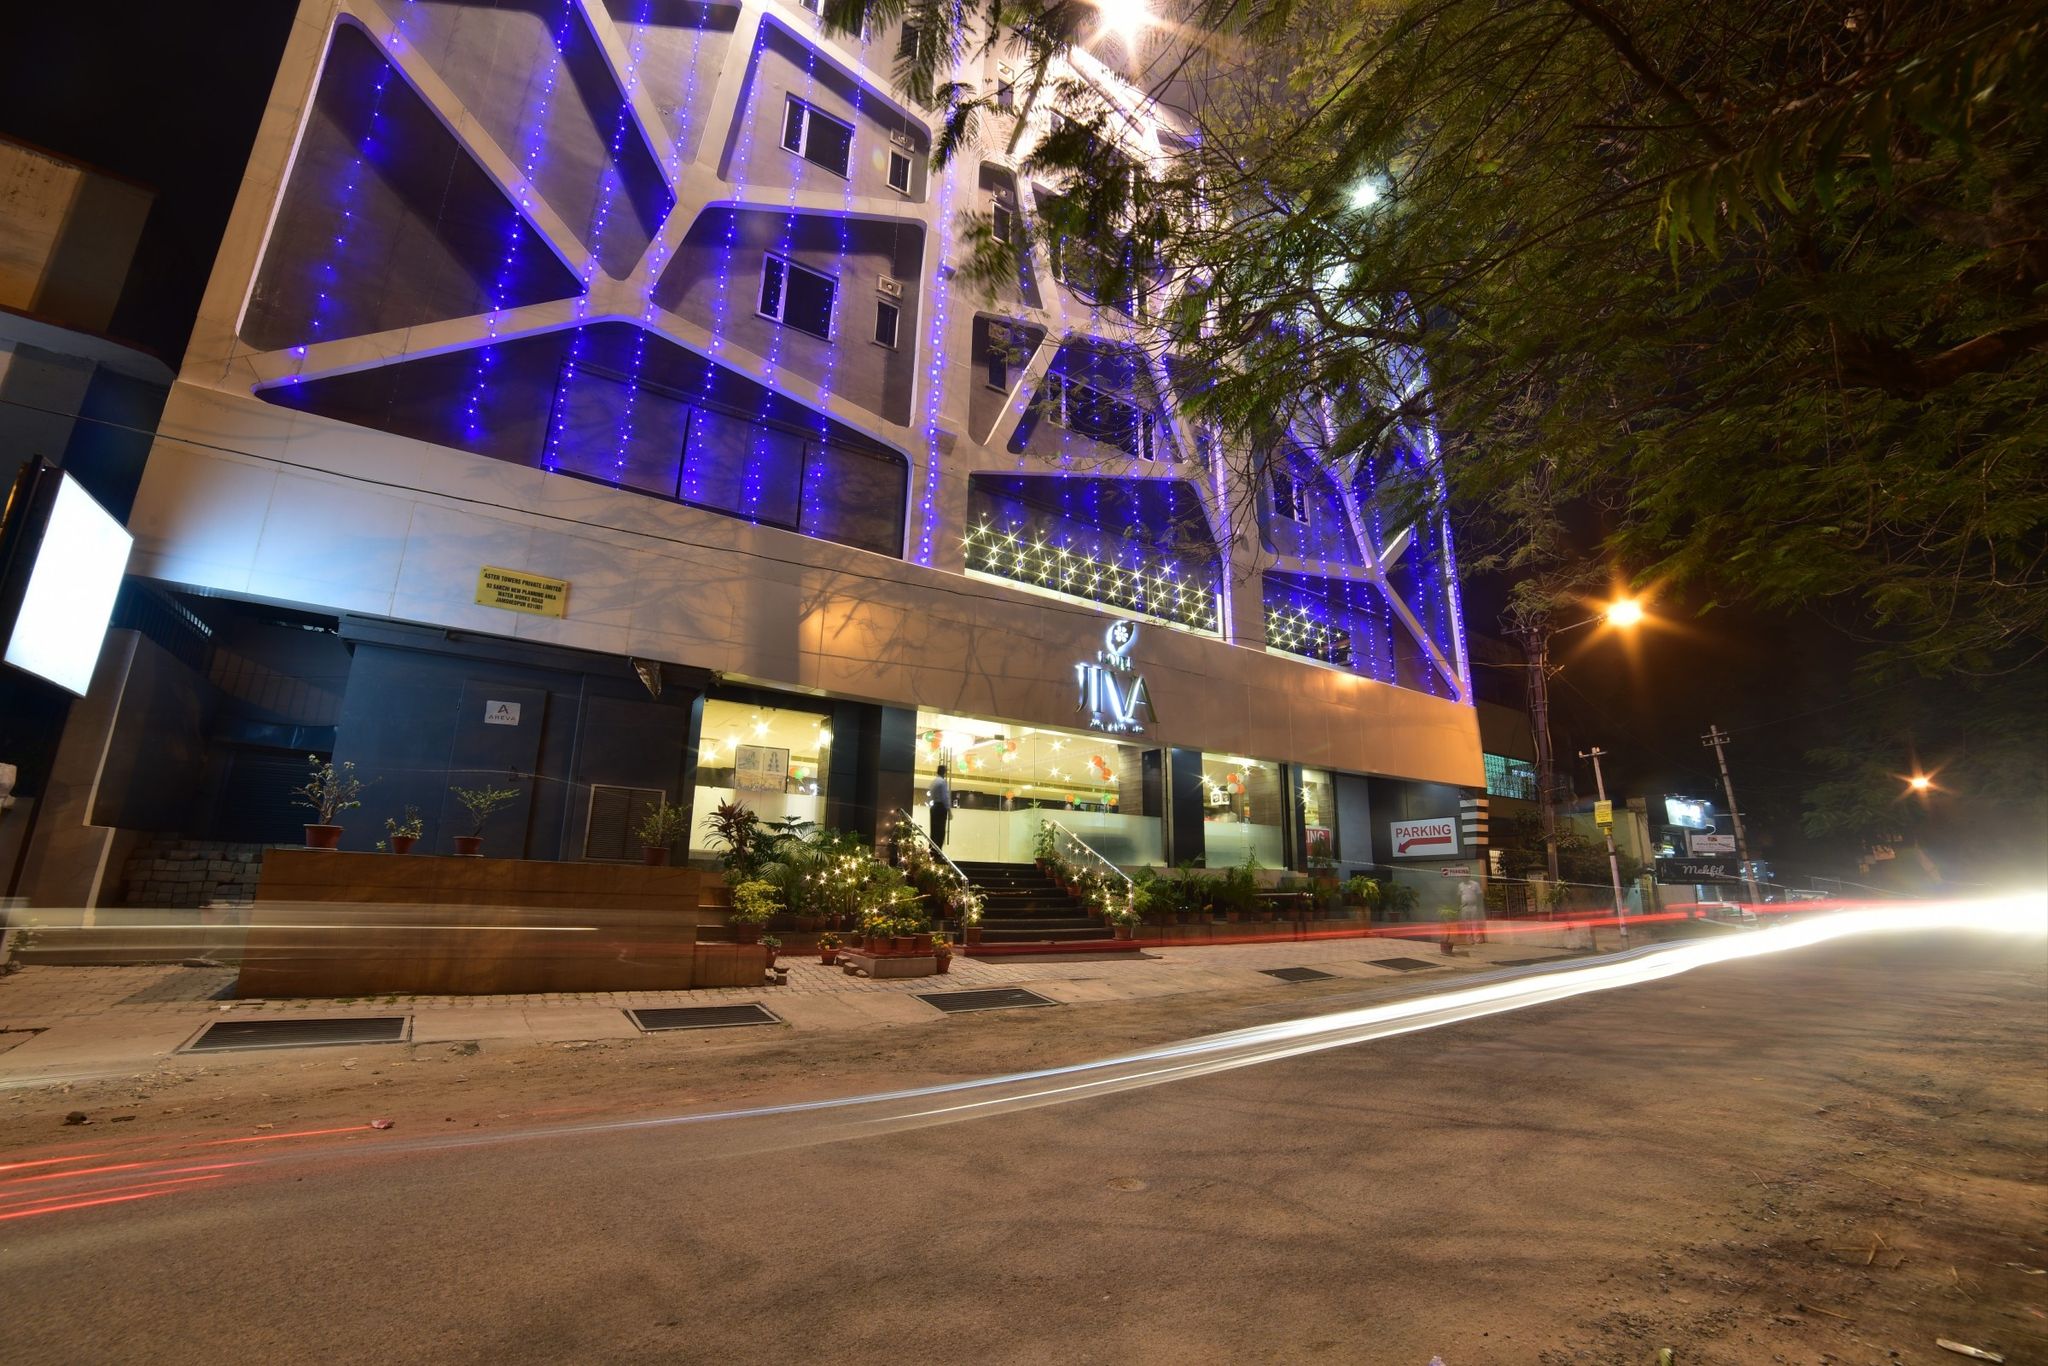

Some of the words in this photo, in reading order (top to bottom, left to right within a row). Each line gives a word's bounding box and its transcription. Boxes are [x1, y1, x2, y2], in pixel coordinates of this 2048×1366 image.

[484, 572, 500, 581] ASTER
[501, 576, 521, 585] TOWERS
[522, 579, 542, 588] PRIVATE
[543, 583, 562, 592] LIMITED
[522, 589, 544, 598] PLANNING
[545, 593, 556, 601] AREA
[1075, 662, 1160, 723] JIVA
[1395, 824, 1452, 838] PARKING
